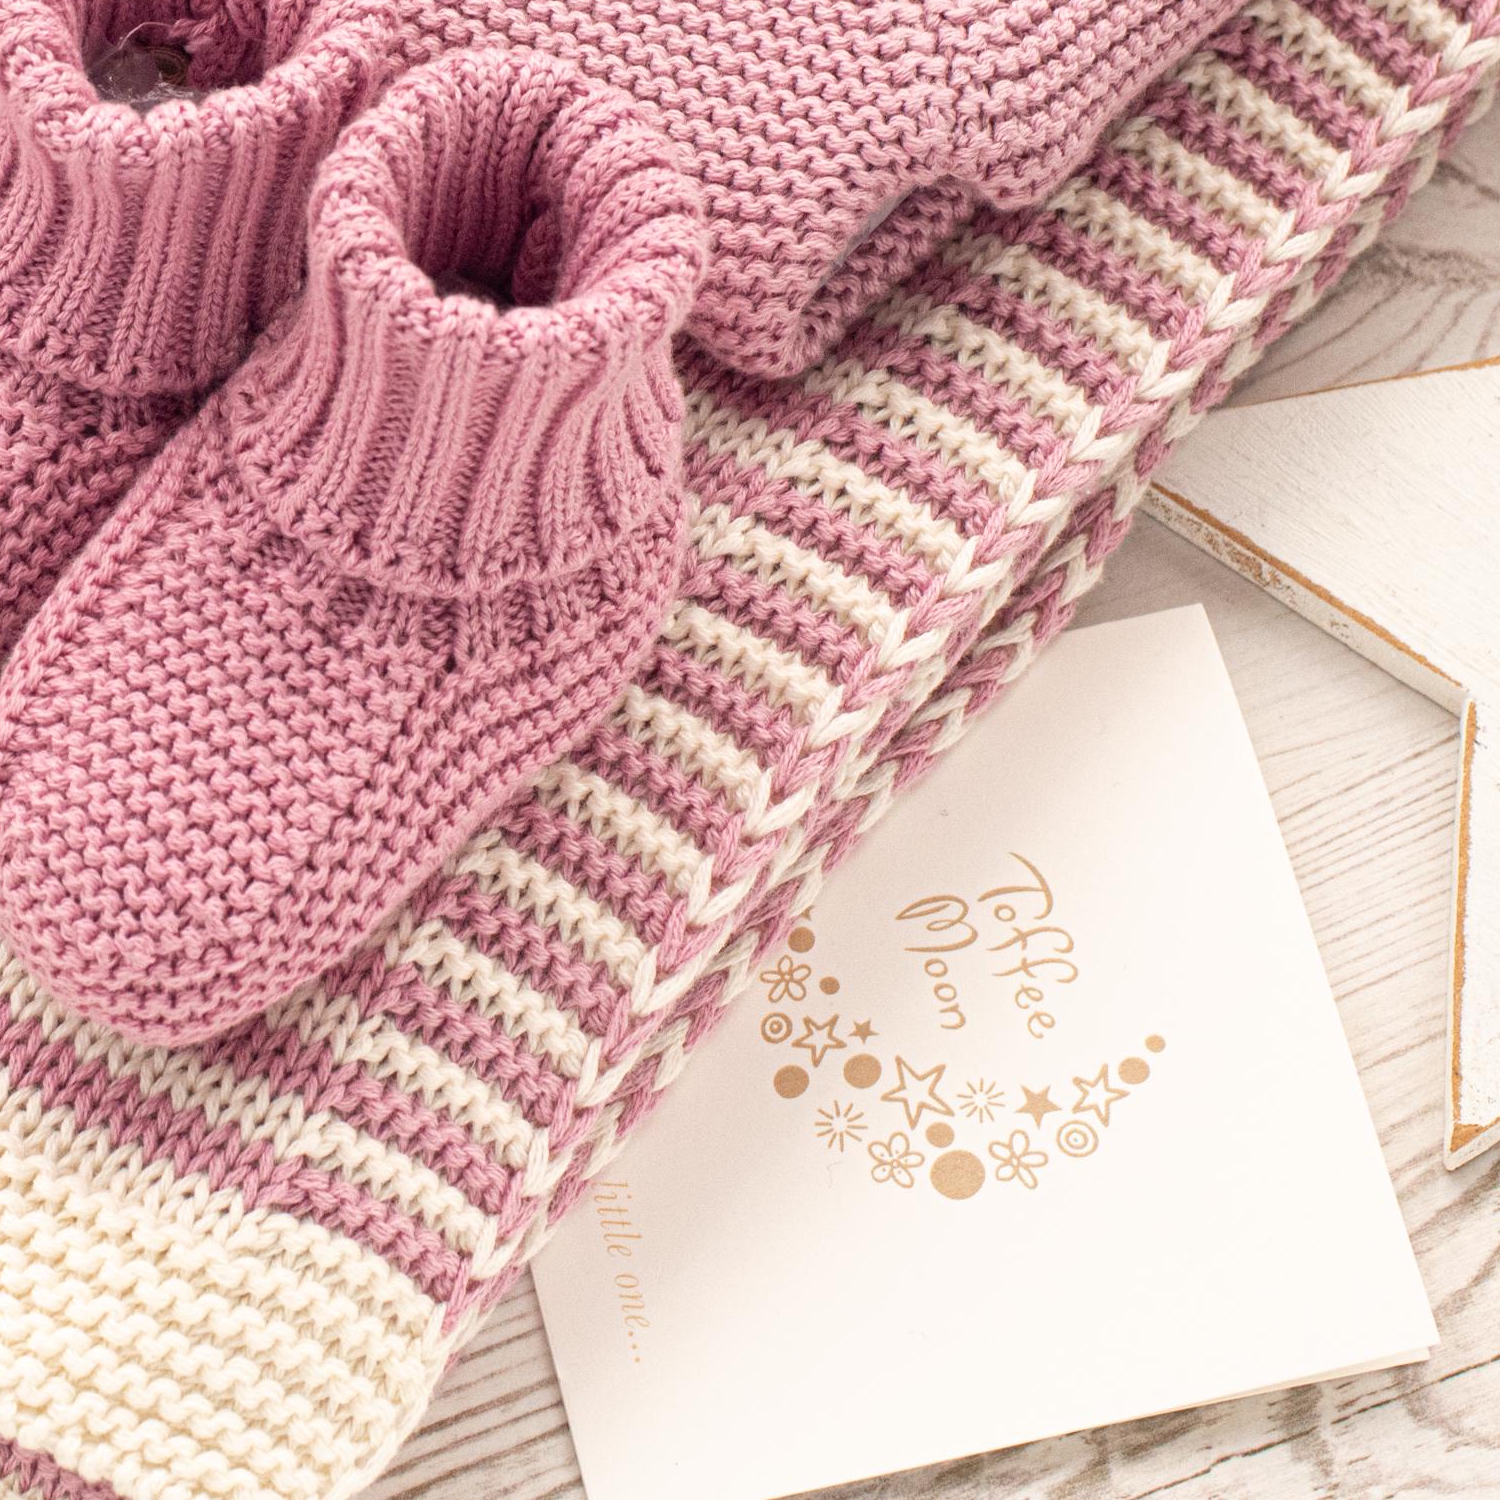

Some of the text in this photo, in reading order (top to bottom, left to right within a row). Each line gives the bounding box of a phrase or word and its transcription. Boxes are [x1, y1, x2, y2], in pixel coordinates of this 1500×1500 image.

[894, 894, 978, 1030] Moon
[977, 851, 1079, 1039] Toffee
[593, 1181, 643, 1258] little
